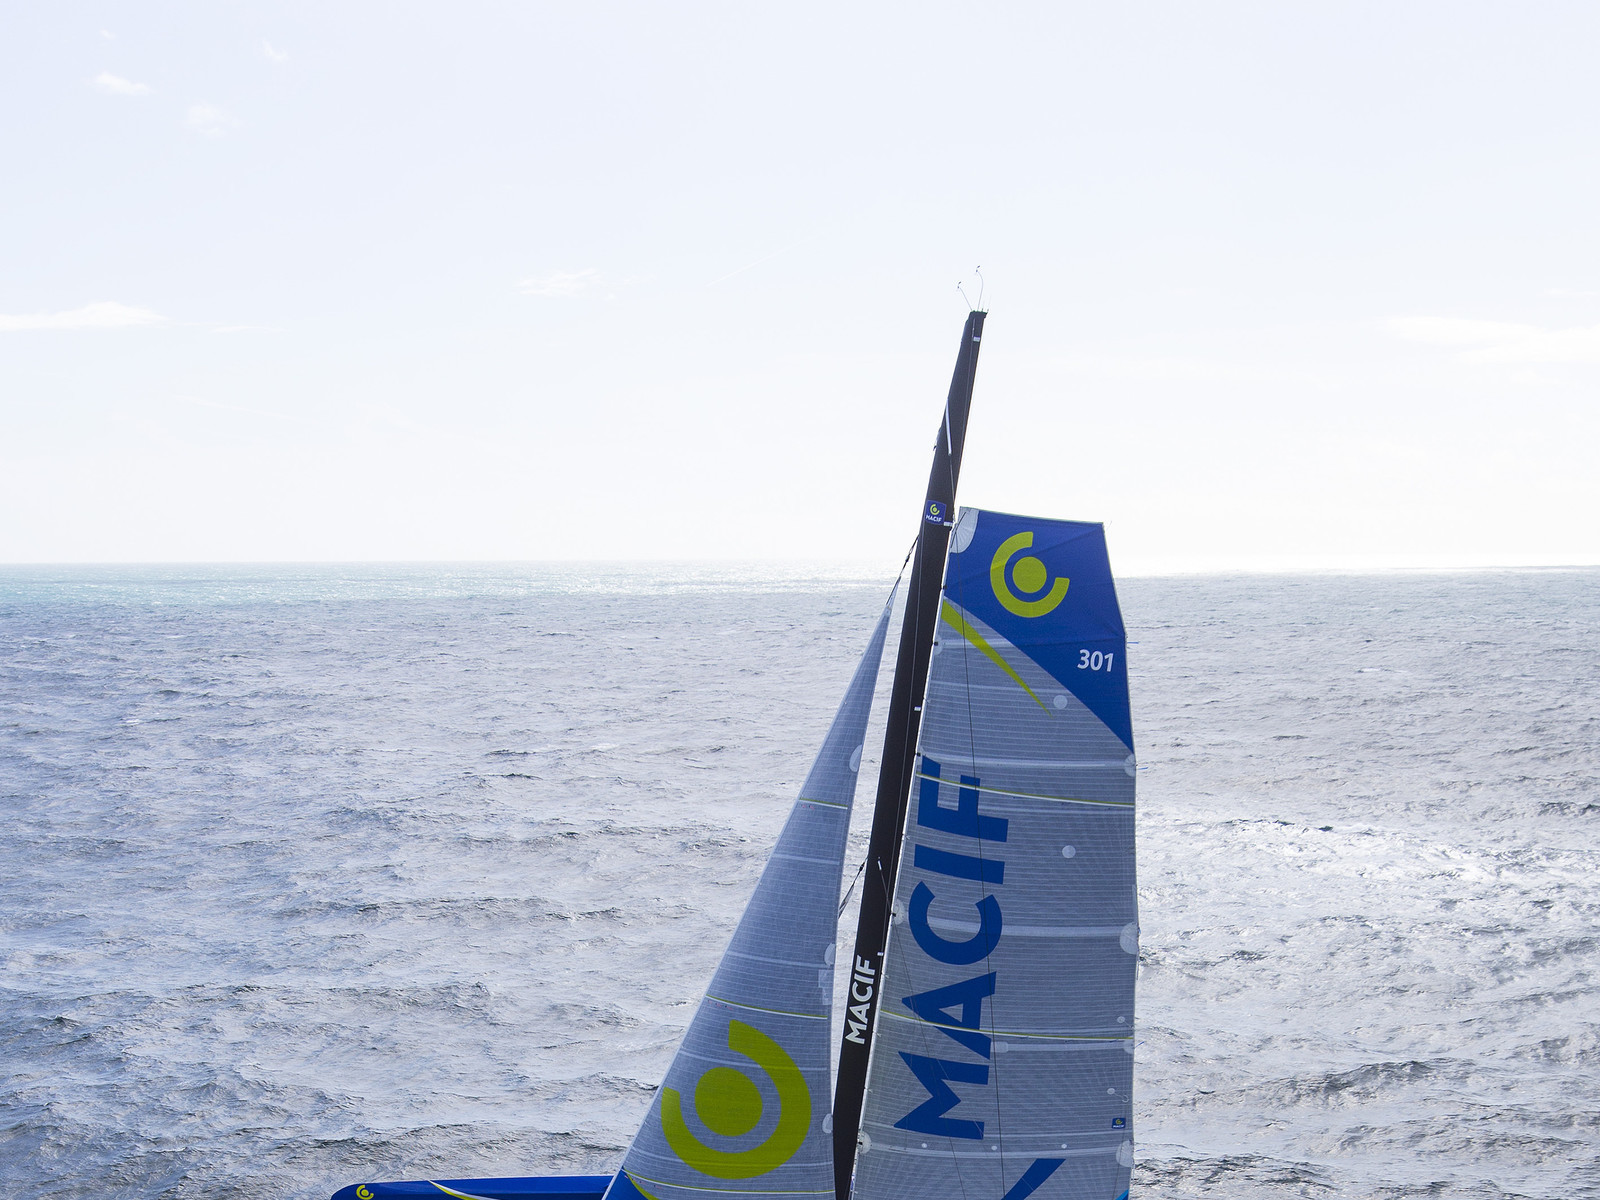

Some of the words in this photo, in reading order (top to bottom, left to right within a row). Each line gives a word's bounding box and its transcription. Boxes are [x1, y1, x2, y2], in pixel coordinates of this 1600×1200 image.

[1077, 649, 1114, 672] 301
[893, 754, 1009, 1140] MACIF
[845, 955, 876, 1045] MACIF
